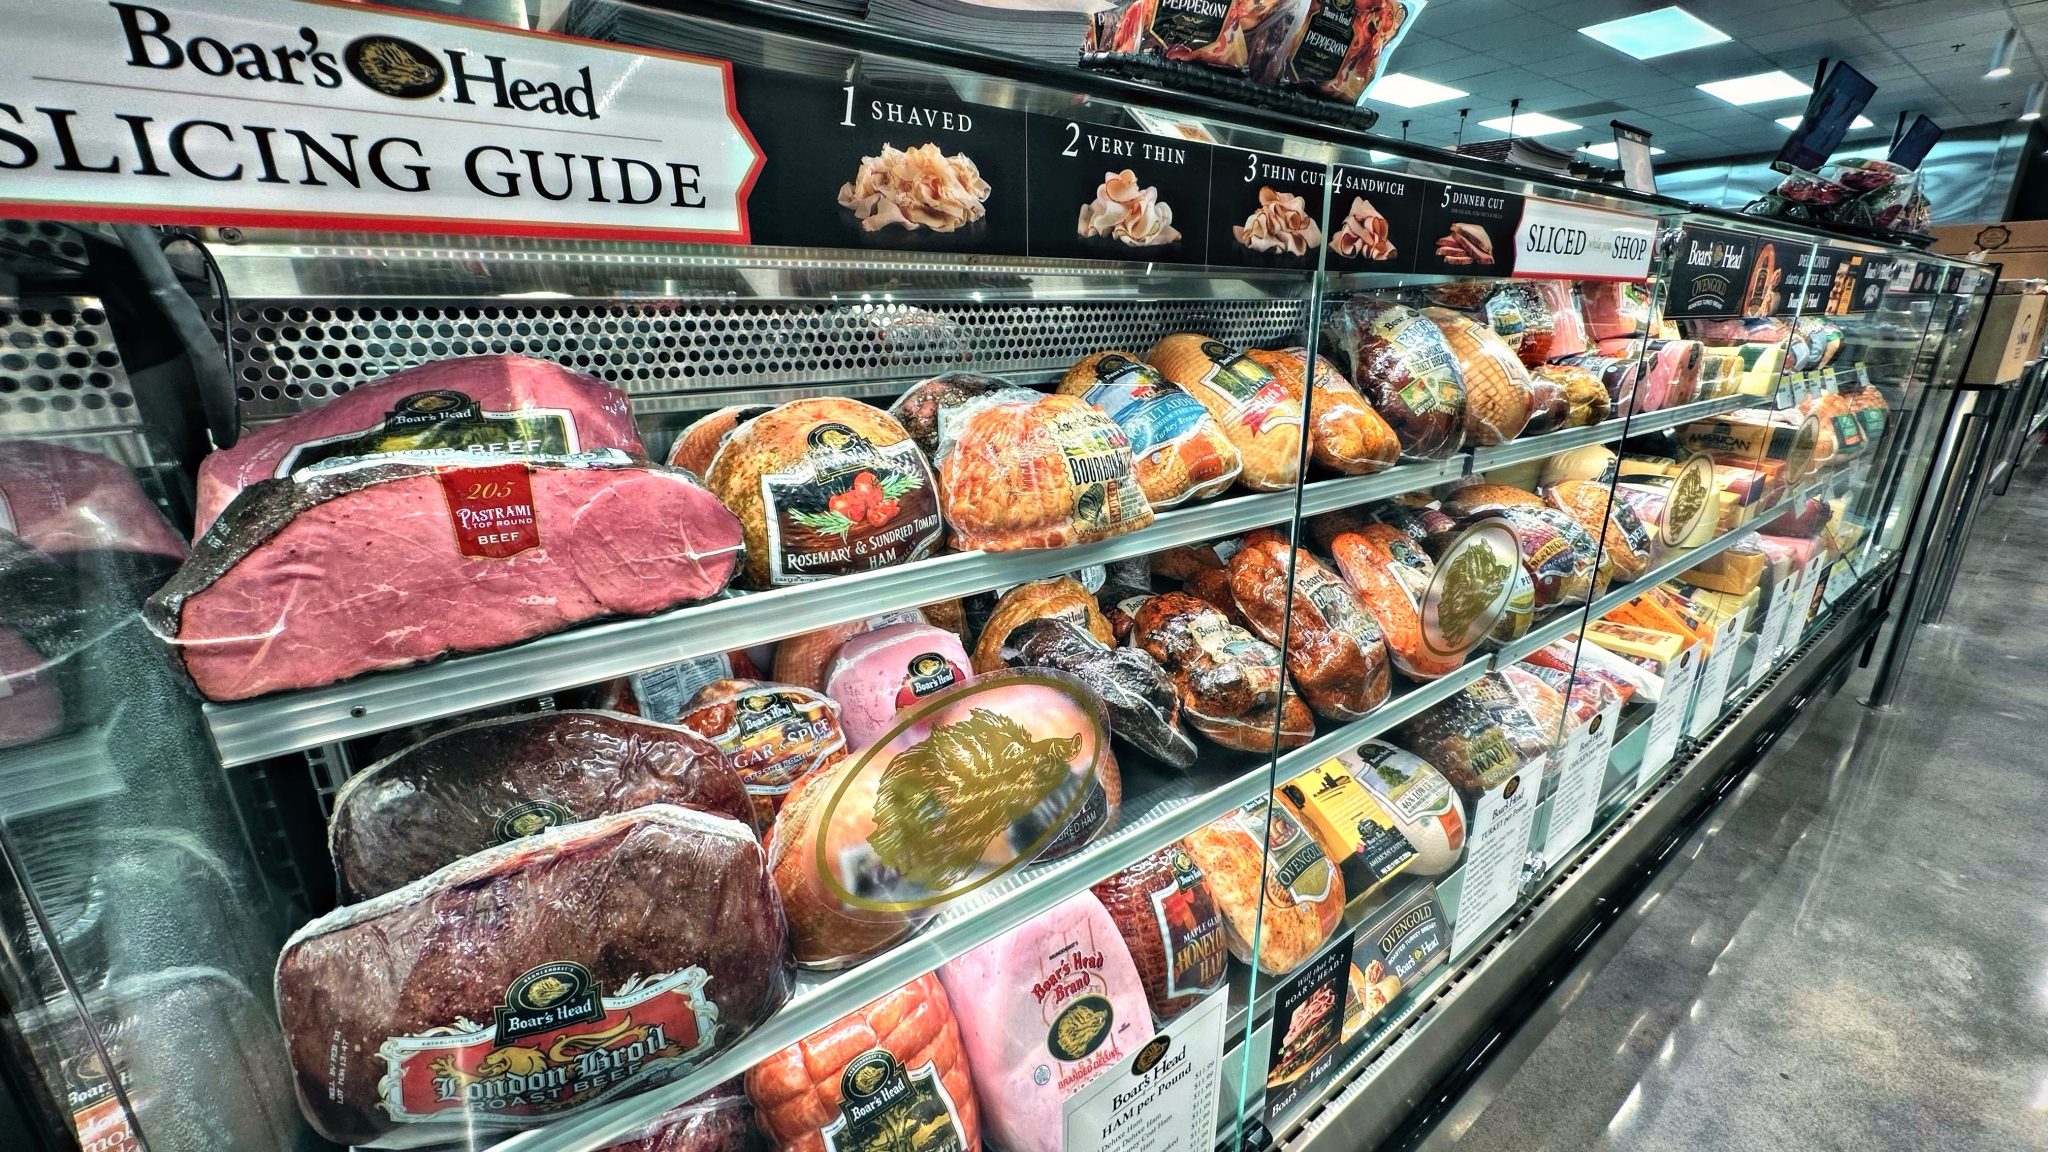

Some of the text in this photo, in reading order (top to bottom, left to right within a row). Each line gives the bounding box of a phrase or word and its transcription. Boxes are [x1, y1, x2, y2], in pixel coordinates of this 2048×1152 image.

[114, 2, 601, 121] Boar's Head
[839, 86, 972, 133] 1 SHAVED
[0, 104, 708, 209] SLICING GUIDE
[1061, 122, 1186, 165] 2 VERY THIN
[1243, 153, 1326, 186] 3 THIN CUT
[1330, 166, 1405, 196] 4 SANDWICH
[1441, 185, 1505, 210] 5 DINNER CUT
[1526, 223, 1587, 256] SLICED
[1688, 239, 1744, 269] Boar's Head
[1798, 254, 1830, 269] DELCIOUS
[1692, 277, 1727, 297] OVENGOLD
[396, 411, 436, 426] Boar's
[1153, 421, 1177, 442] Turkey
[468, 439, 541, 454] BEEF
[466, 481, 516, 500] 205
[1108, 480, 1121, 523] SMOKED
[456, 504, 531, 529] PASTRAMI
[472, 517, 533, 530] TOP ROUND
[477, 532, 520, 545] BEEF
[787, 514, 938, 572] ROSEMARY & SUNDRIED TOMATO
[869, 548, 897, 569] HAM
[914, 672, 955, 693] Boar's Head
[745, 711, 772, 730] Boar's
[729, 743, 775, 768] GAR
[787, 718, 831, 745] SPICE
[782, 752, 806, 767] BONE
[1483, 766, 1511, 784] TURKEY
[1081, 810, 1097, 828] HAM
[1481, 820, 1503, 841] TURKEY
[1183, 924, 1206, 943] MAPLE
[1382, 905, 1433, 953] OVENGOLD
[1388, 921, 1437, 966] ROASTED TURKEY BREAST
[1175, 930, 1216, 973] HONEY
[1395, 933, 1440, 978] Boar's Head
[1032, 950, 1104, 1004] Boar's Head
[1053, 970, 1091, 1004] Brand
[1285, 953, 1345, 1008] BOAR'S HEAD?
[612, 985, 664, 1005] FAMILY OWNED
[508, 998, 592, 1032] Boar's Head
[432, 1065, 568, 1103] London
[574, 1023, 668, 1077] Broil
[1111, 1044, 1187, 1112] Boar's Head
[470, 1086, 562, 1111] ROAST
[574, 1062, 642, 1092] BEEF
[851, 1078, 905, 1122] Boar's Head
[1102, 1063, 1192, 1140] HAM per Pound
[1271, 1055, 1333, 1118] Boar's Head
[1101, 1131, 1126, 1152] Deluxe
[1127, 1118, 1143, 1133] Ham
[1122, 1127, 1146, 1148] Deluxe
[1146, 1113, 1162, 1128] Ham
[1141, 1127, 1157, 1142] Coat
[1158, 1114, 1173, 1129] Ham
